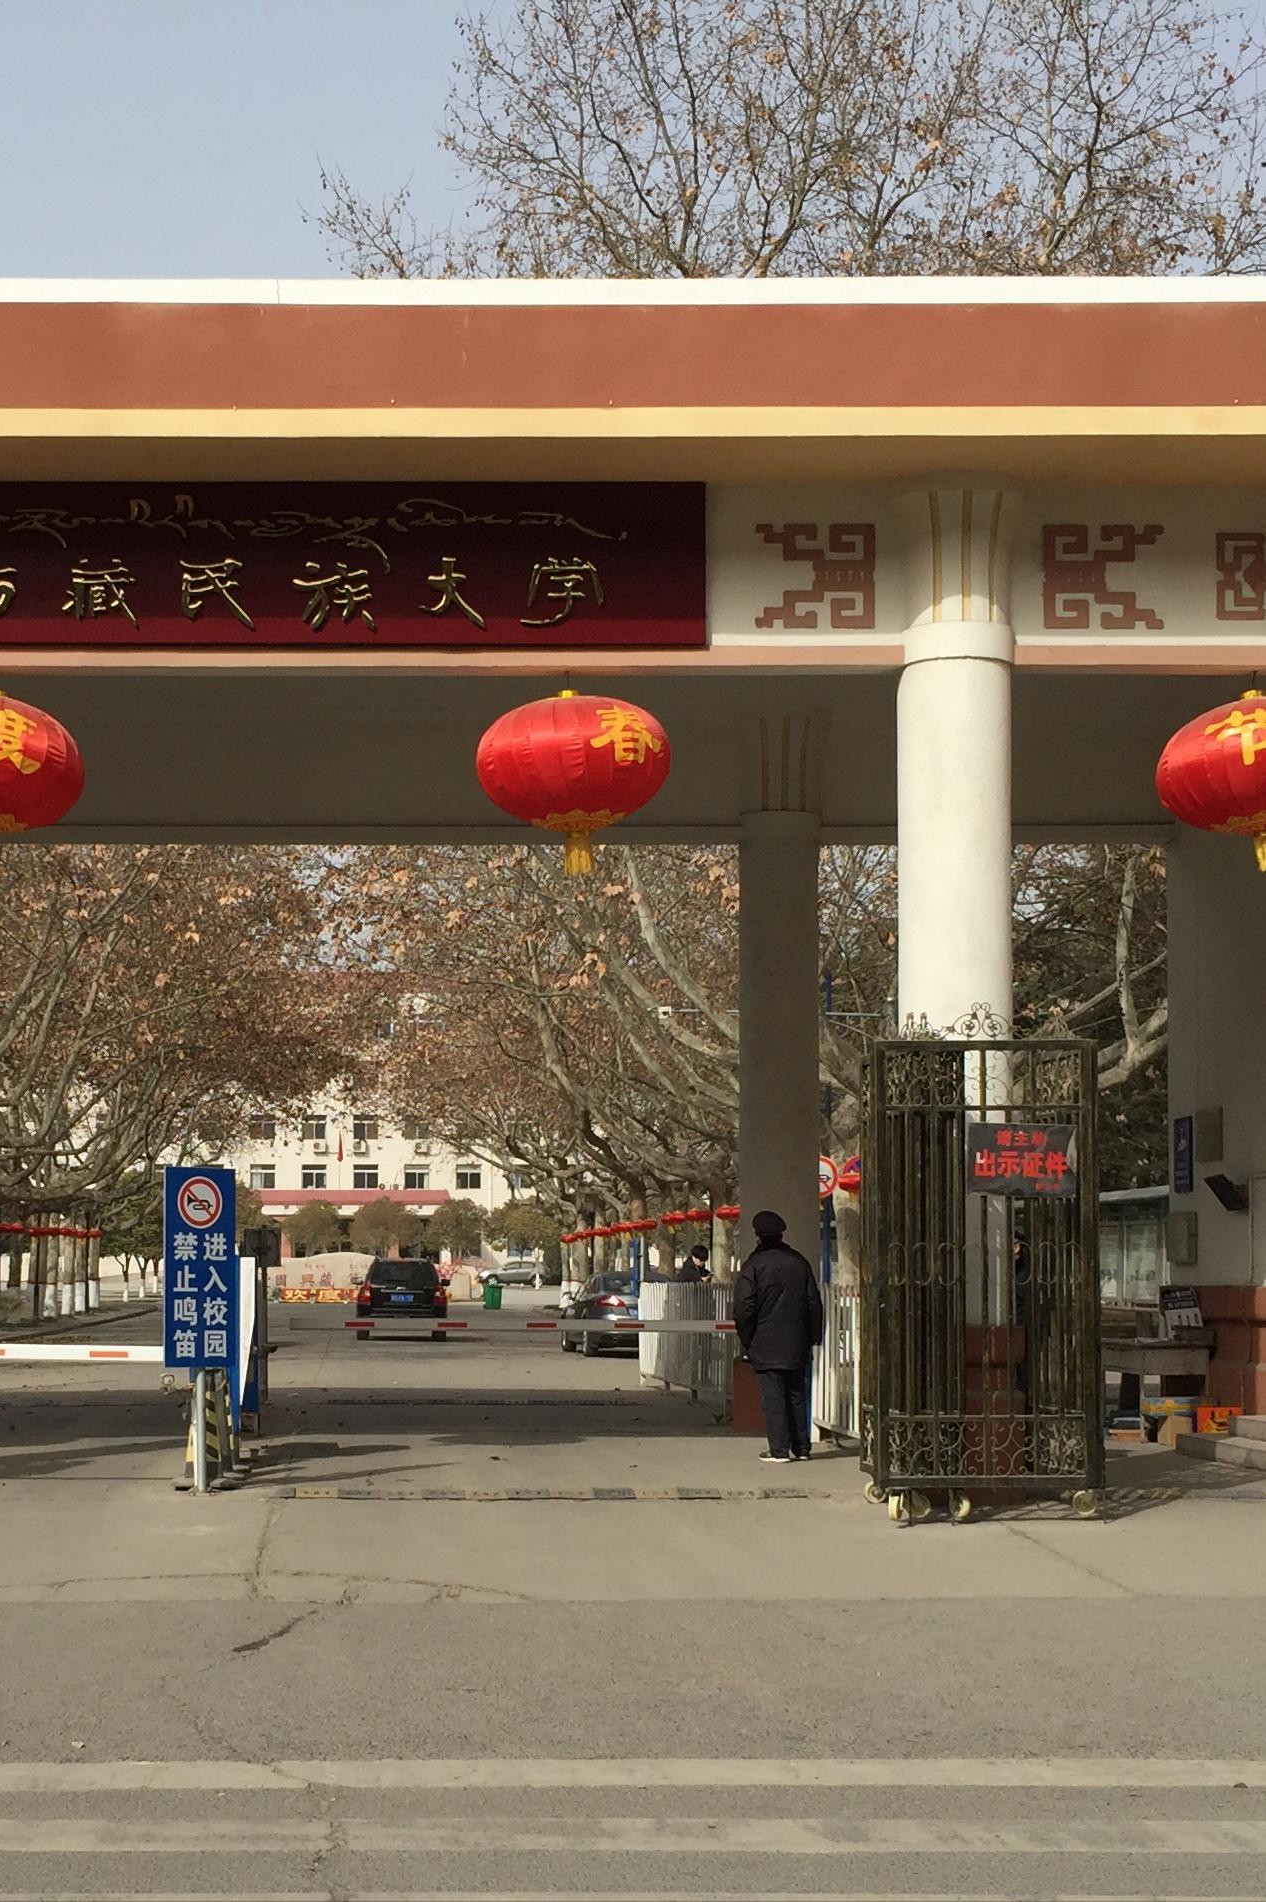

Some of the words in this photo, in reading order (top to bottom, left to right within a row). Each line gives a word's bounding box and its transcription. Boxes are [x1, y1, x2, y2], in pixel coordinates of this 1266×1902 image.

[590, 705, 662, 764] 春
[1205, 708, 1266, 765] 节
[974, 1149, 1068, 1180] 出示证件
[173, 1231, 198, 1358] 禁止鸣笛
[203, 1232, 228, 1358] 进入校园
